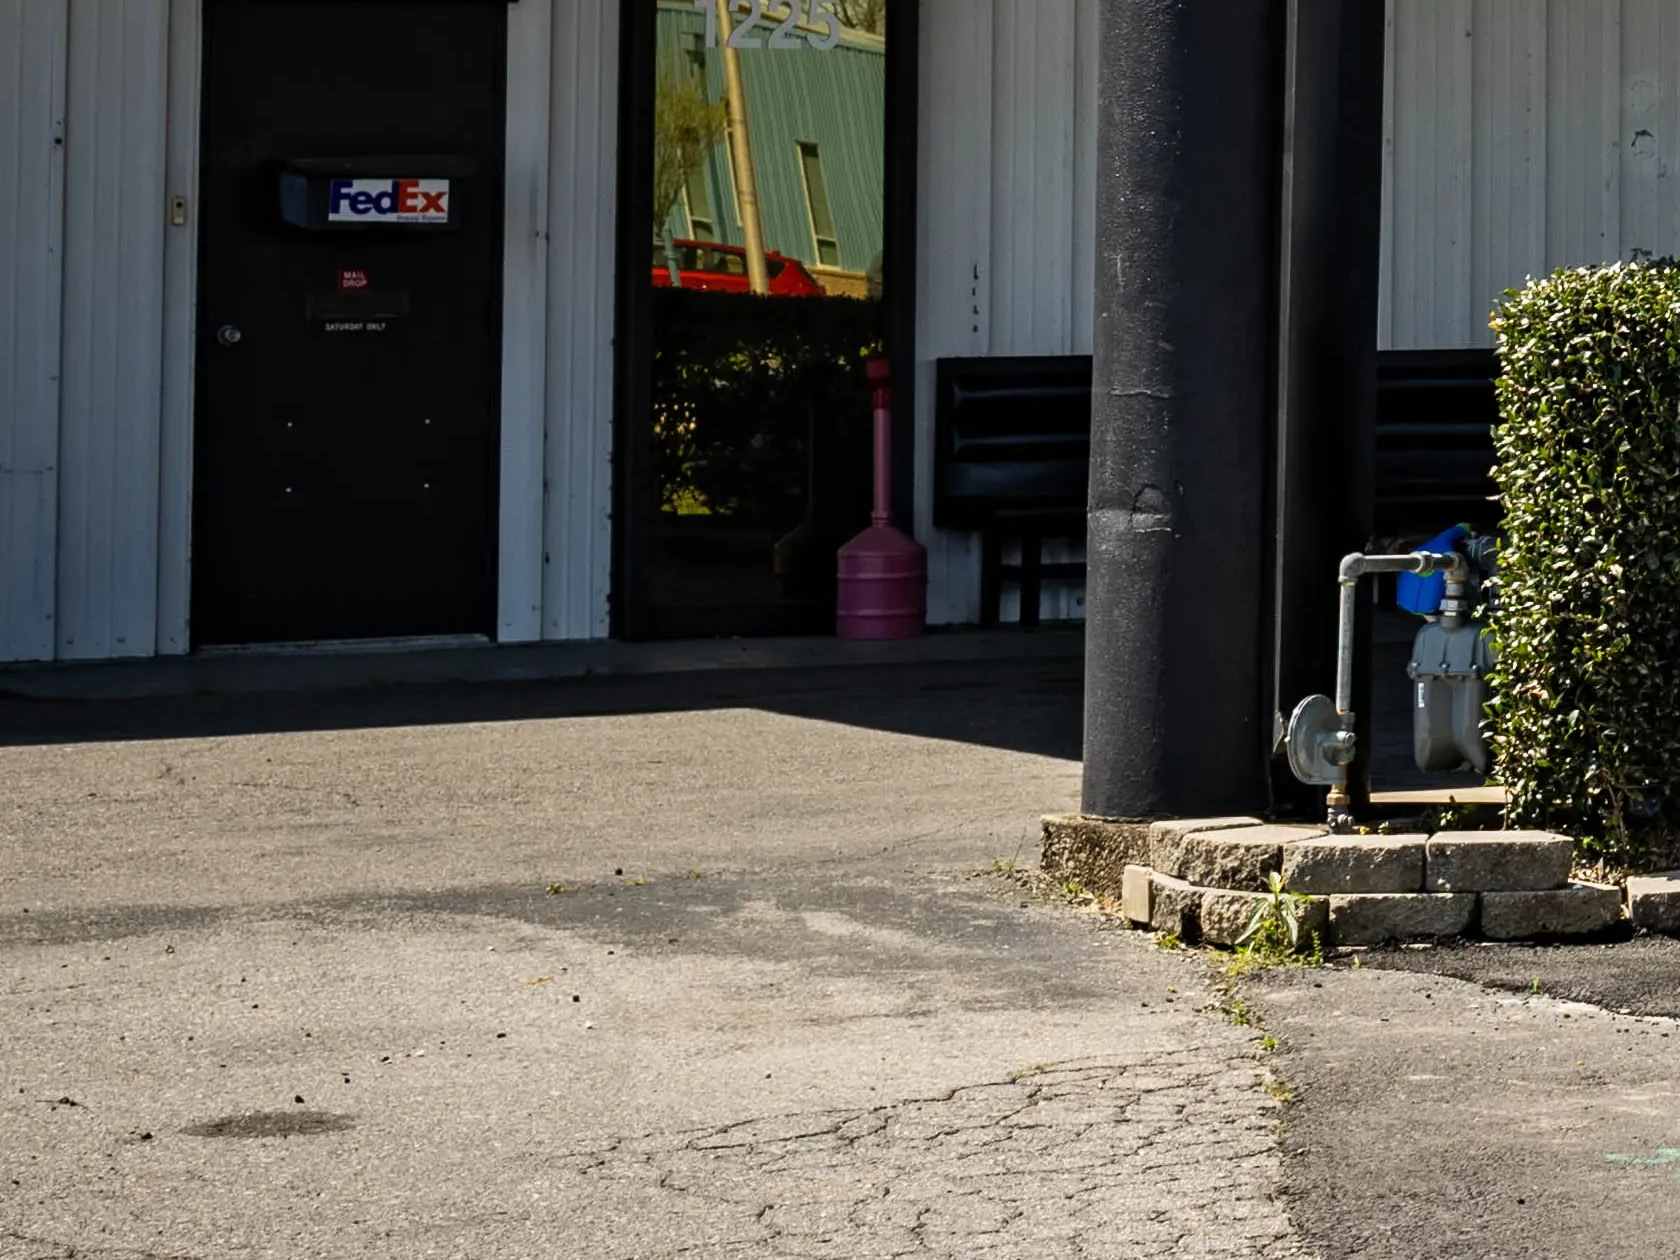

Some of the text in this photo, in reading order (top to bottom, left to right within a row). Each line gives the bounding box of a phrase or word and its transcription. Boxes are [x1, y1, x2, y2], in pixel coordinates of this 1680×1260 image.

[330, 179, 447, 214] FedEx
[343, 271, 366, 279] MAIL
[343, 279, 368, 288] DROP
[325, 322, 386, 331] SATURDAY ONLY
